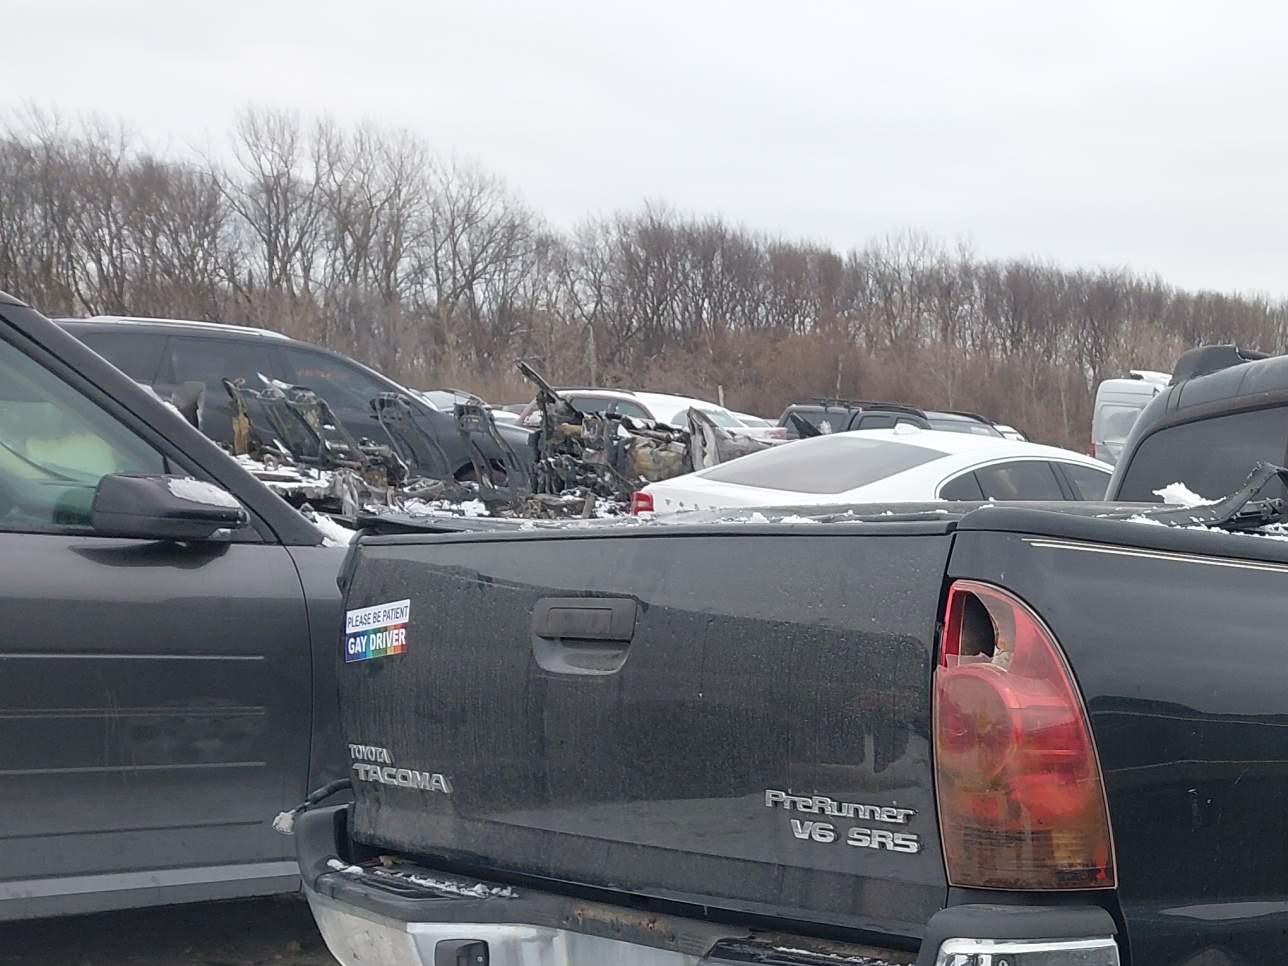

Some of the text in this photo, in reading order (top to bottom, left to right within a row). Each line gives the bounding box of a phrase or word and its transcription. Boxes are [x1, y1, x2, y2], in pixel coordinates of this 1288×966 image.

[347, 605, 409, 628] PLEASE BE PATIENT
[348, 628, 406, 655] GAY DRIVER
[348, 743, 392, 764] TOYOTA
[352, 763, 452, 794] TACOMA
[765, 789, 919, 823] PreRunner
[790, 819, 921, 854] V6 SR5
